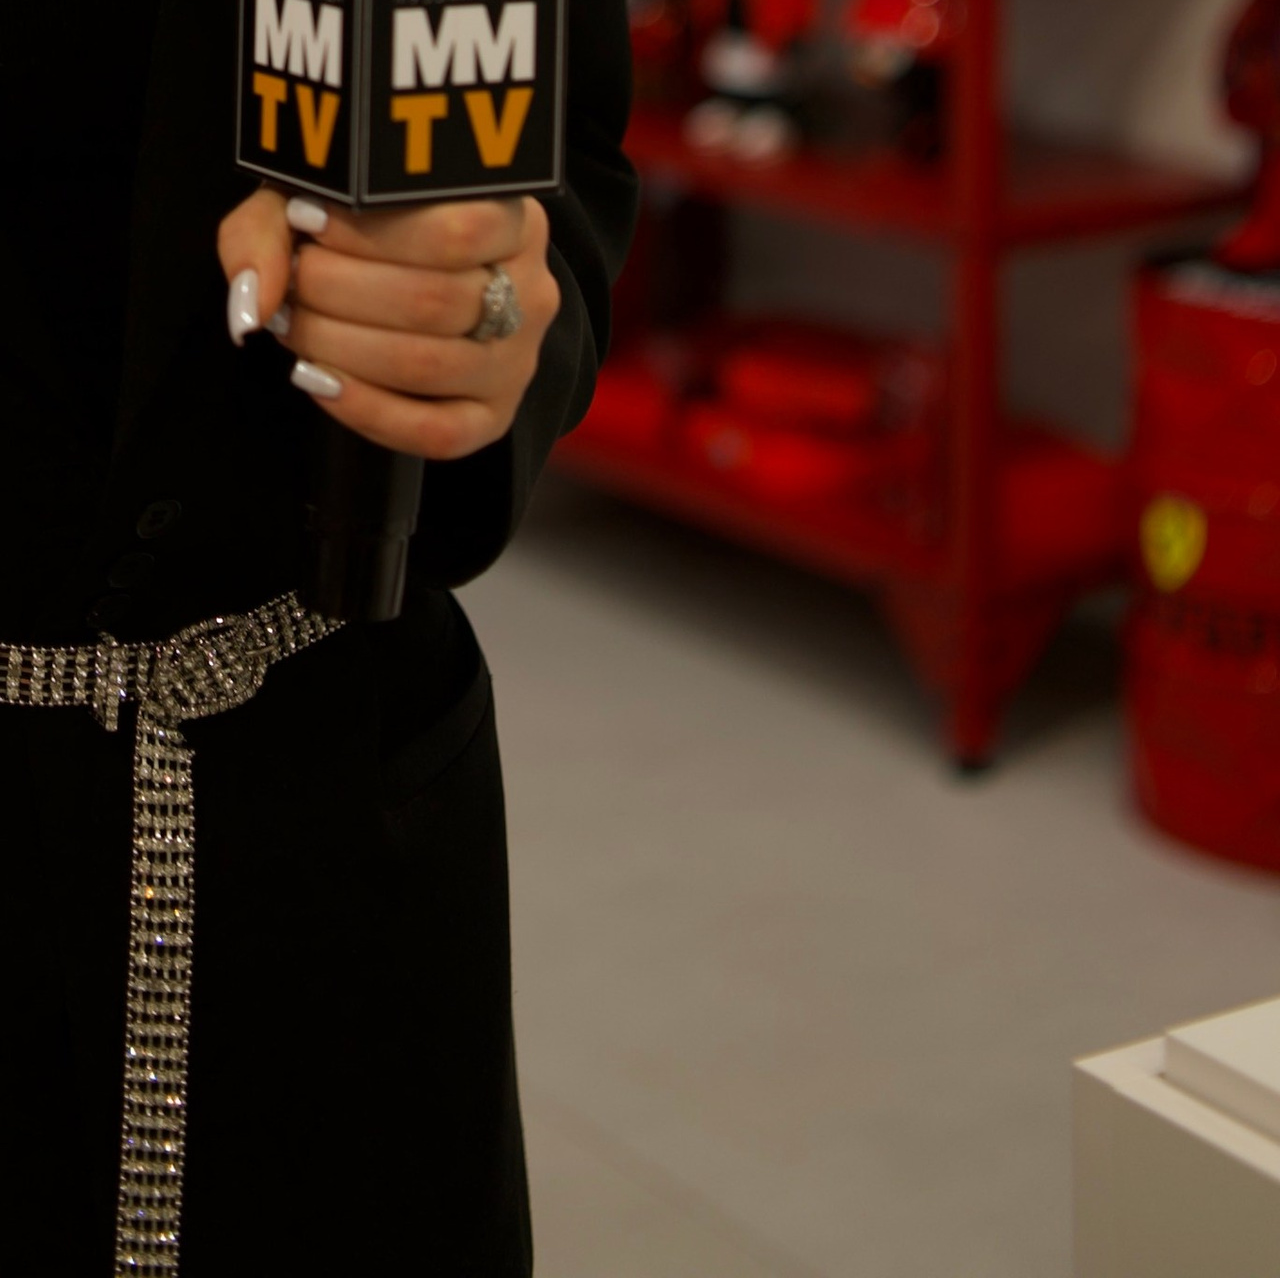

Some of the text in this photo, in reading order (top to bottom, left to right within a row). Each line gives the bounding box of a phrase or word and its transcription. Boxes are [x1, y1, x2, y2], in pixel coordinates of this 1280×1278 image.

[391, 1, 537, 90] MM
[252, 71, 340, 168] TV
[390, 87, 535, 174] TV
